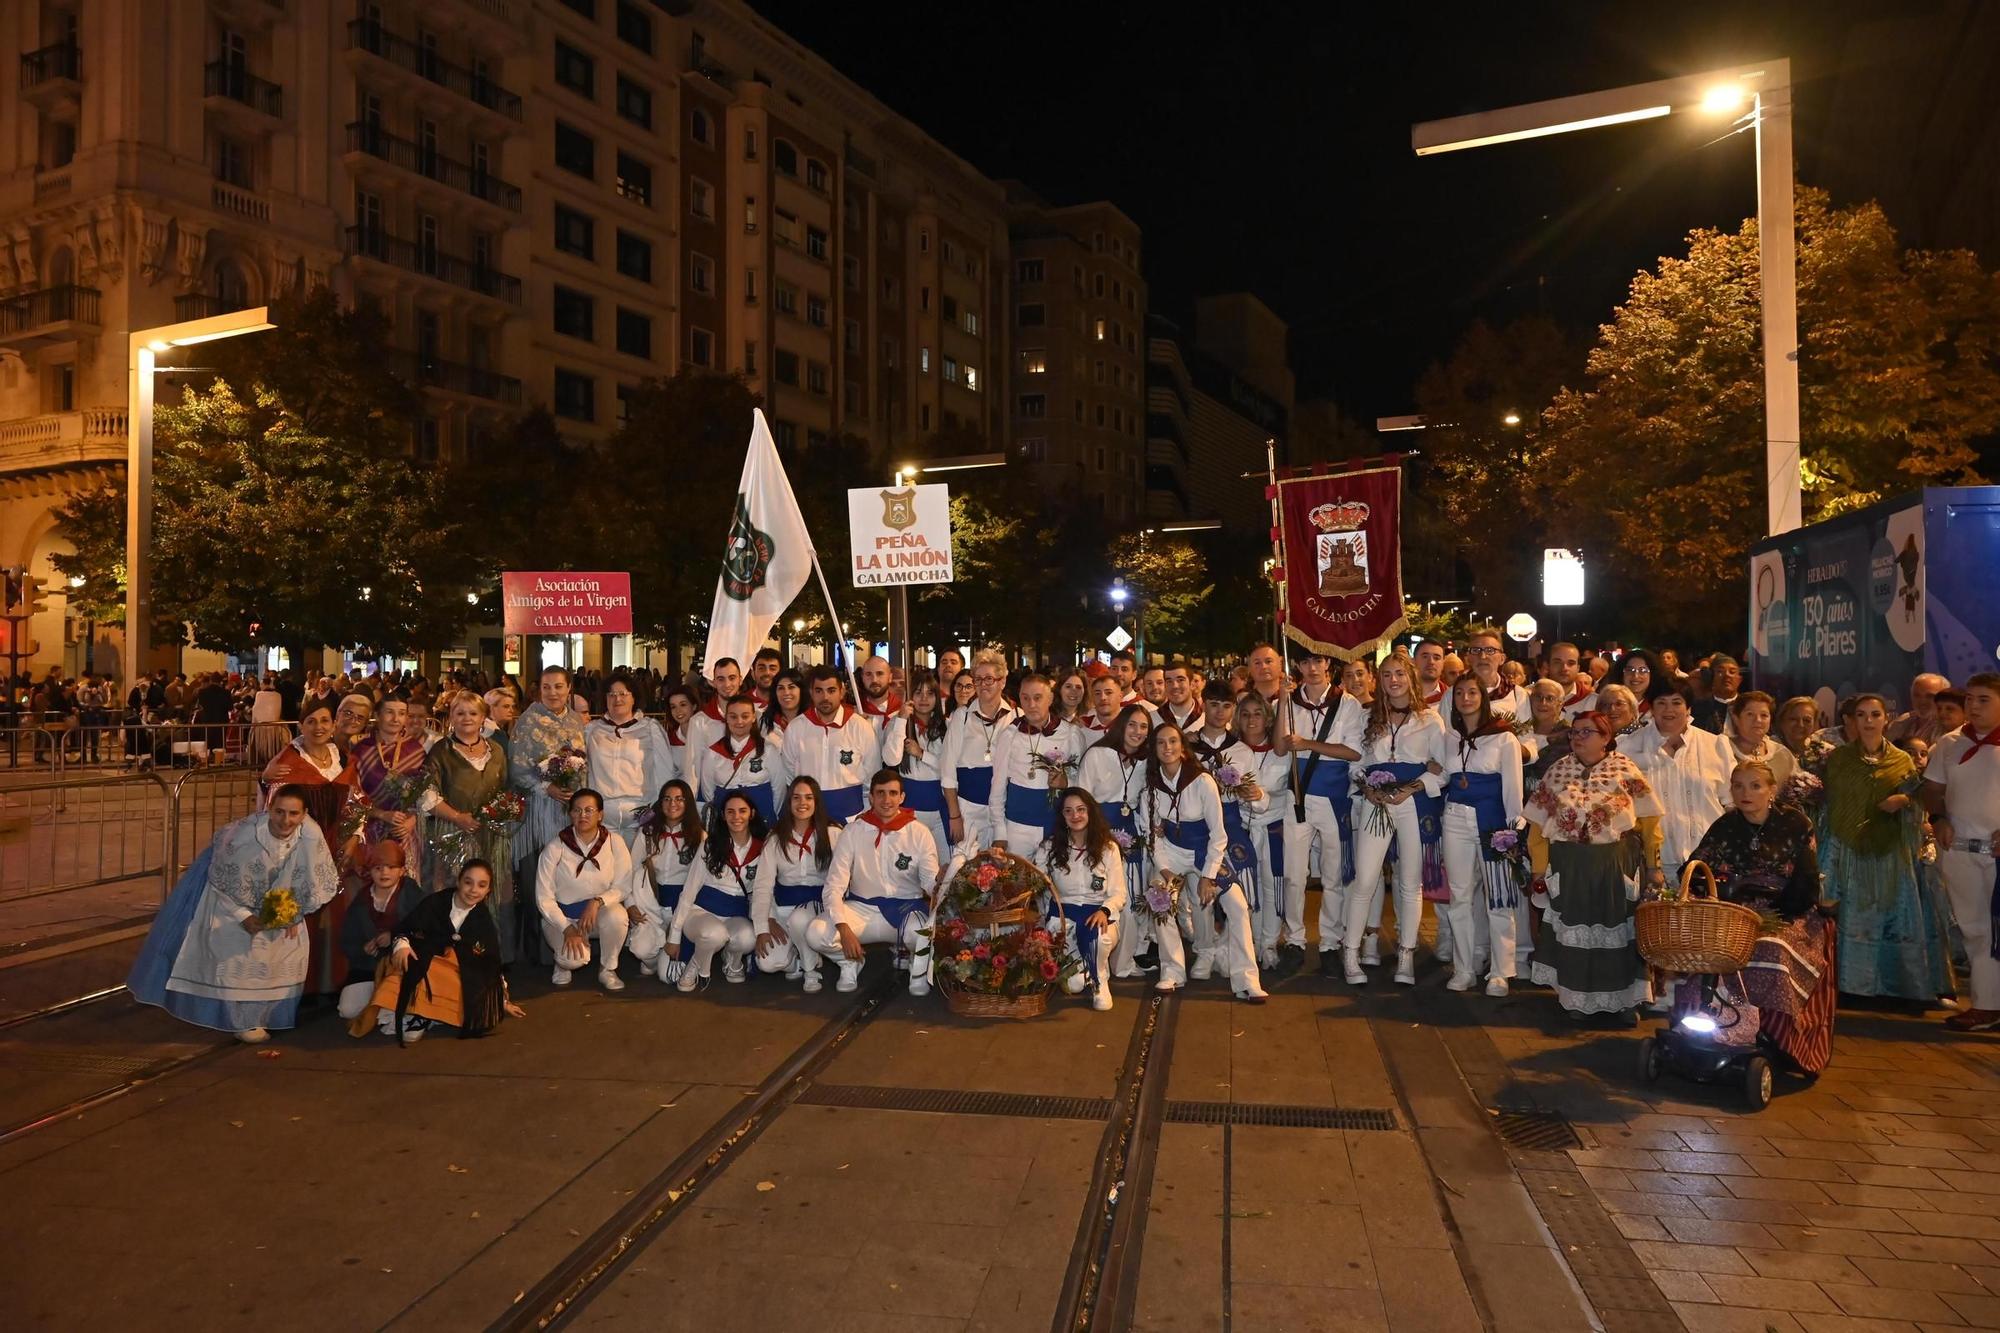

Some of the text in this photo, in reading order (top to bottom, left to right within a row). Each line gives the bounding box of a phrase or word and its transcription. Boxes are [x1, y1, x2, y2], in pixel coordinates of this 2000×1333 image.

[876, 532, 928, 550] PEÑA
[856, 548, 949, 570] LA UNIÓN
[535, 577, 600, 592] Asociación
[857, 569, 950, 585] CALAMOCHA
[508, 592, 627, 610] Amigos de la Virgen
[1305, 592, 1384, 623] CALAMOCHA
[1802, 595, 1824, 626] 130
[534, 615, 604, 627] CALAMOCHA
[1798, 624, 1856, 659] de Pilares
